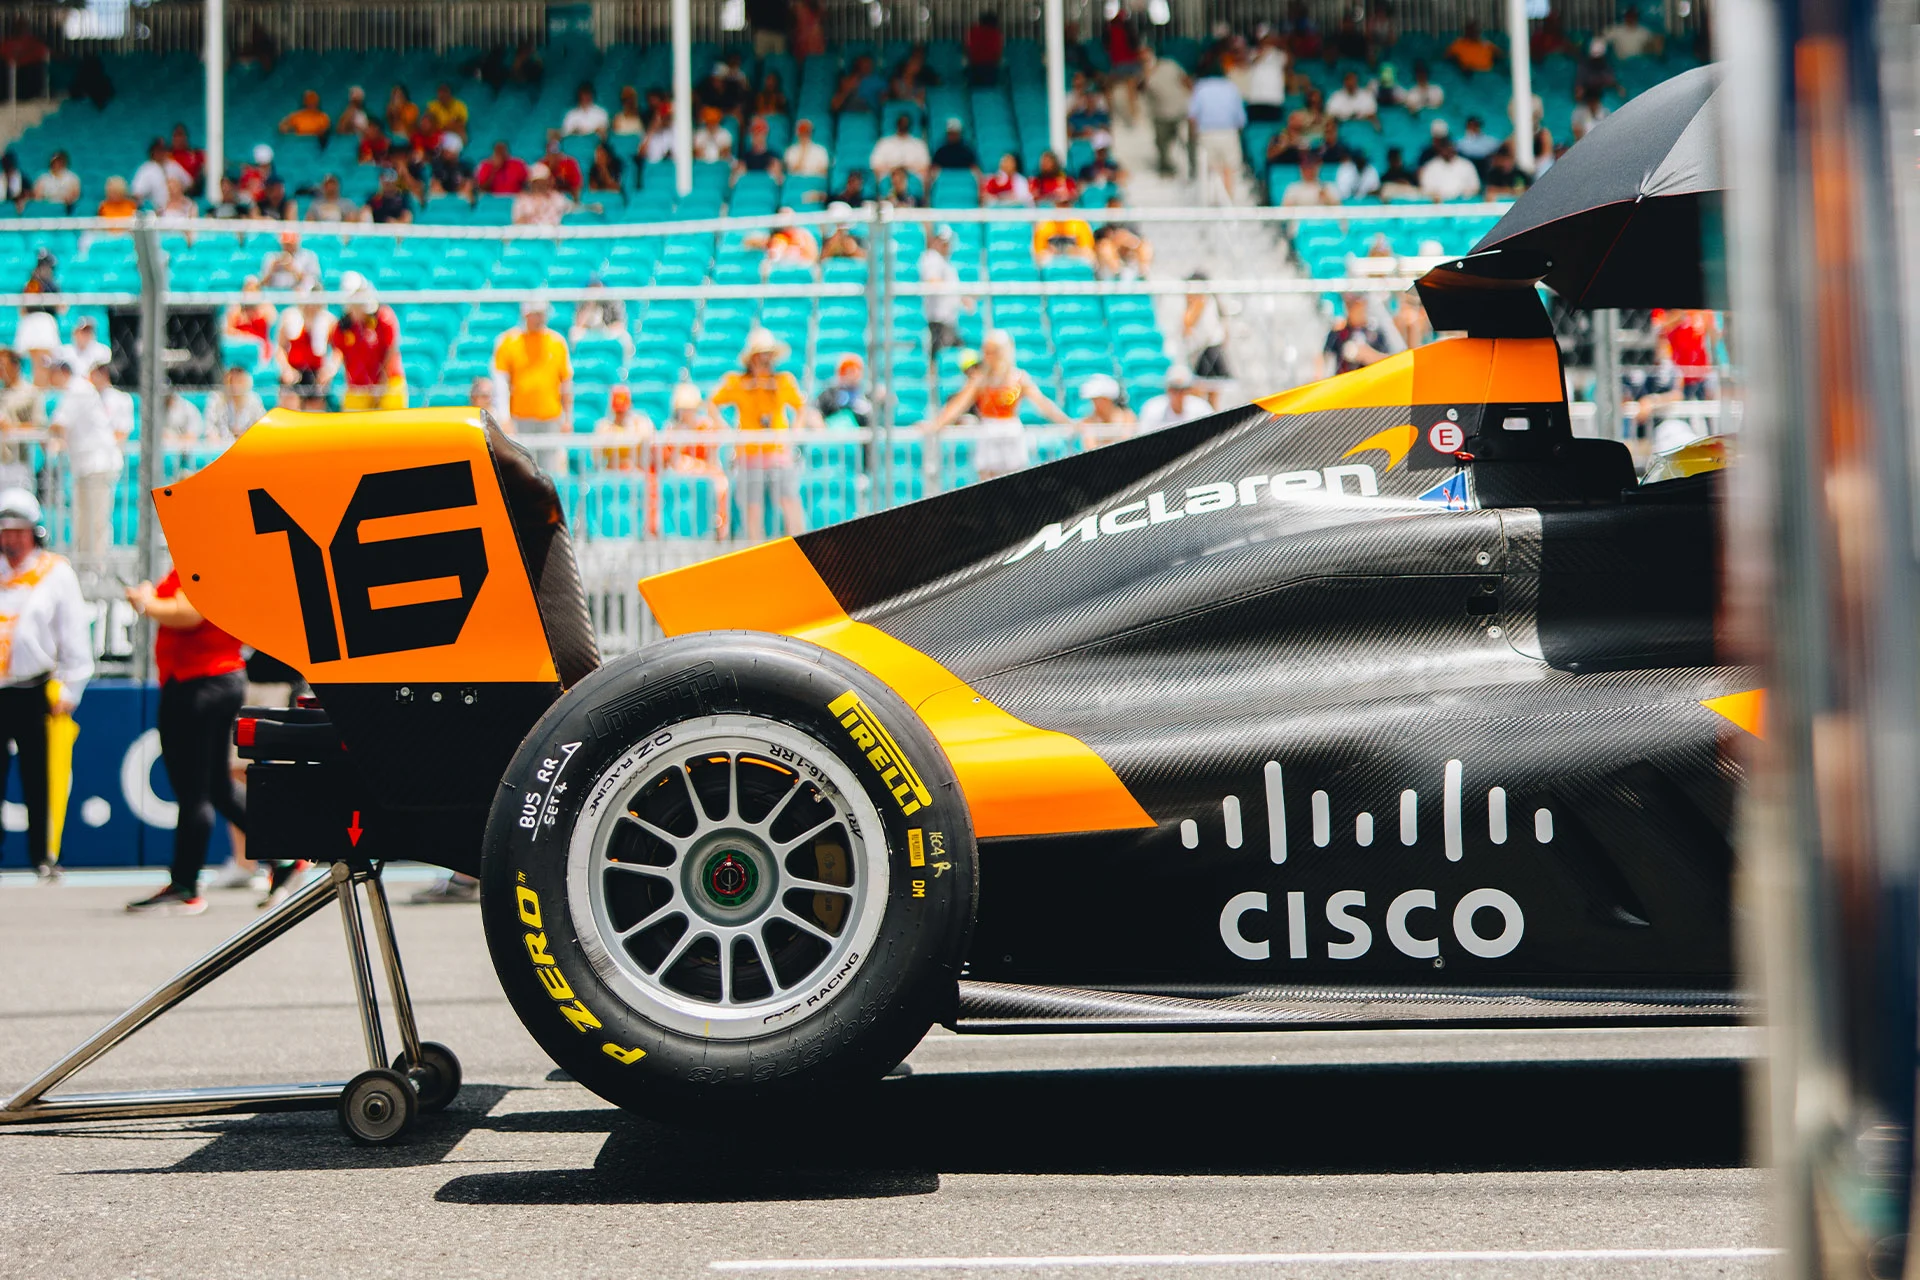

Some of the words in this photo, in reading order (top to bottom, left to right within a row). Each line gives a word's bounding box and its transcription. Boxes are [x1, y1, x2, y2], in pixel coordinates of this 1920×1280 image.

[1438, 429, 1454, 446] E
[1002, 463, 1378, 565] McLaren
[247, 460, 489, 664] 16
[769, 744, 795, 762] RR
[827, 689, 933, 817] PIRELLI
[519, 792, 541, 829] BUS
[537, 758, 559, 783] RR
[544, 797, 560, 826] SET
[555, 781, 568, 793] 4
[912, 880, 925, 898] DM
[1219, 888, 1525, 960] CISCO
[806, 952, 860, 1007] RACING
[602, 1042, 648, 1065] P
